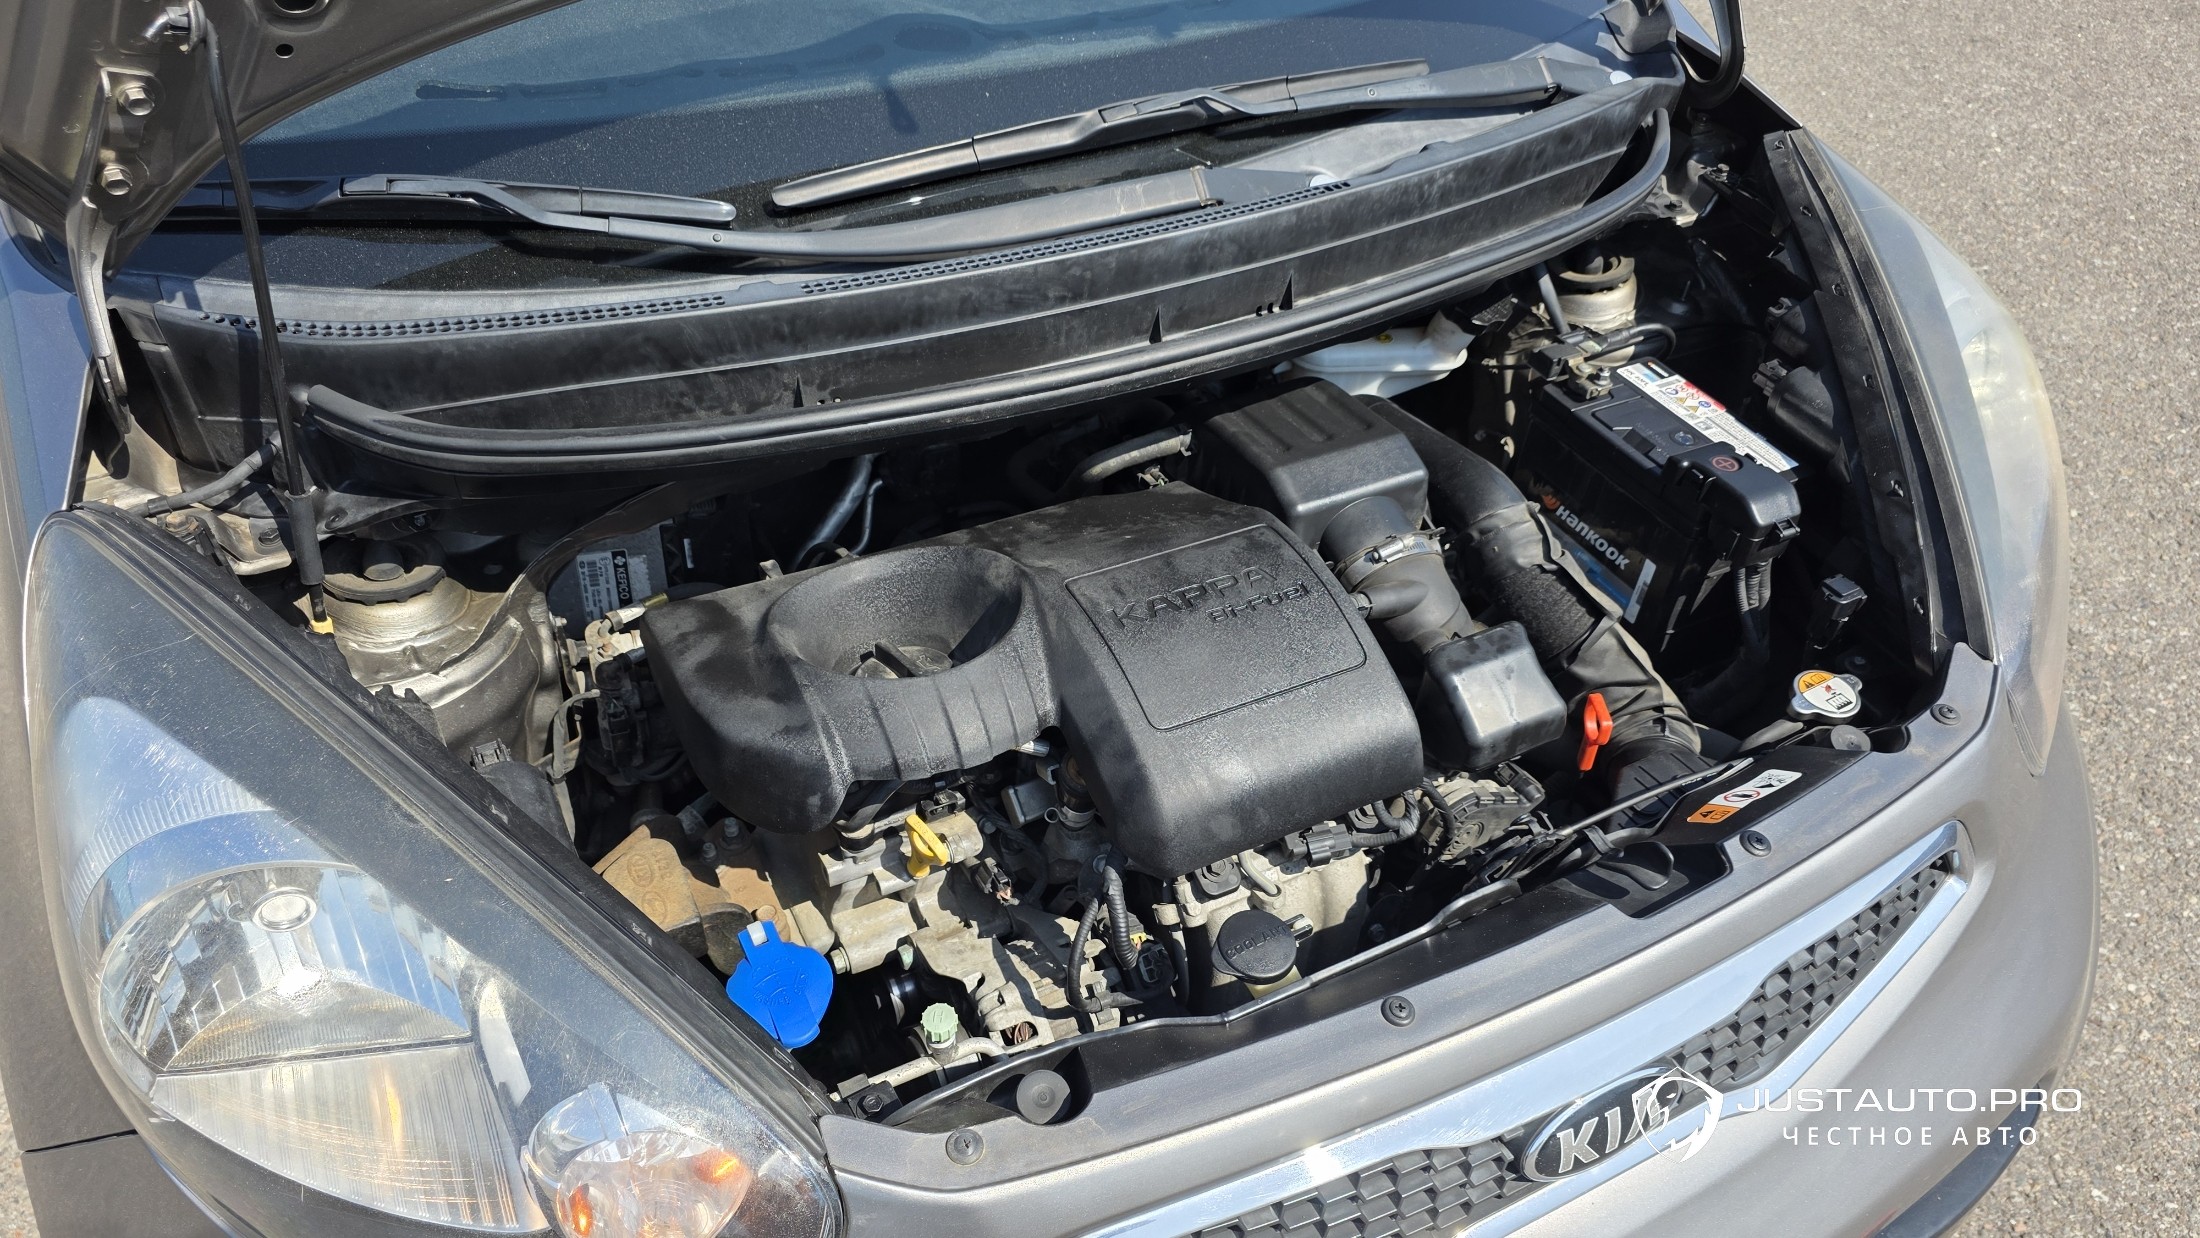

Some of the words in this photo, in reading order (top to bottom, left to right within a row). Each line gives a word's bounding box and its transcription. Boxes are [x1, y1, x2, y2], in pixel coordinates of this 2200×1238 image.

[616, 567, 630, 600] KEFICO
[1106, 565, 1278, 630] KAPPA
[1206, 581, 1310, 624] Bi-Fuel
[1226, 926, 1288, 960] COOLANT
[1556, 1087, 1662, 1174] KIA
